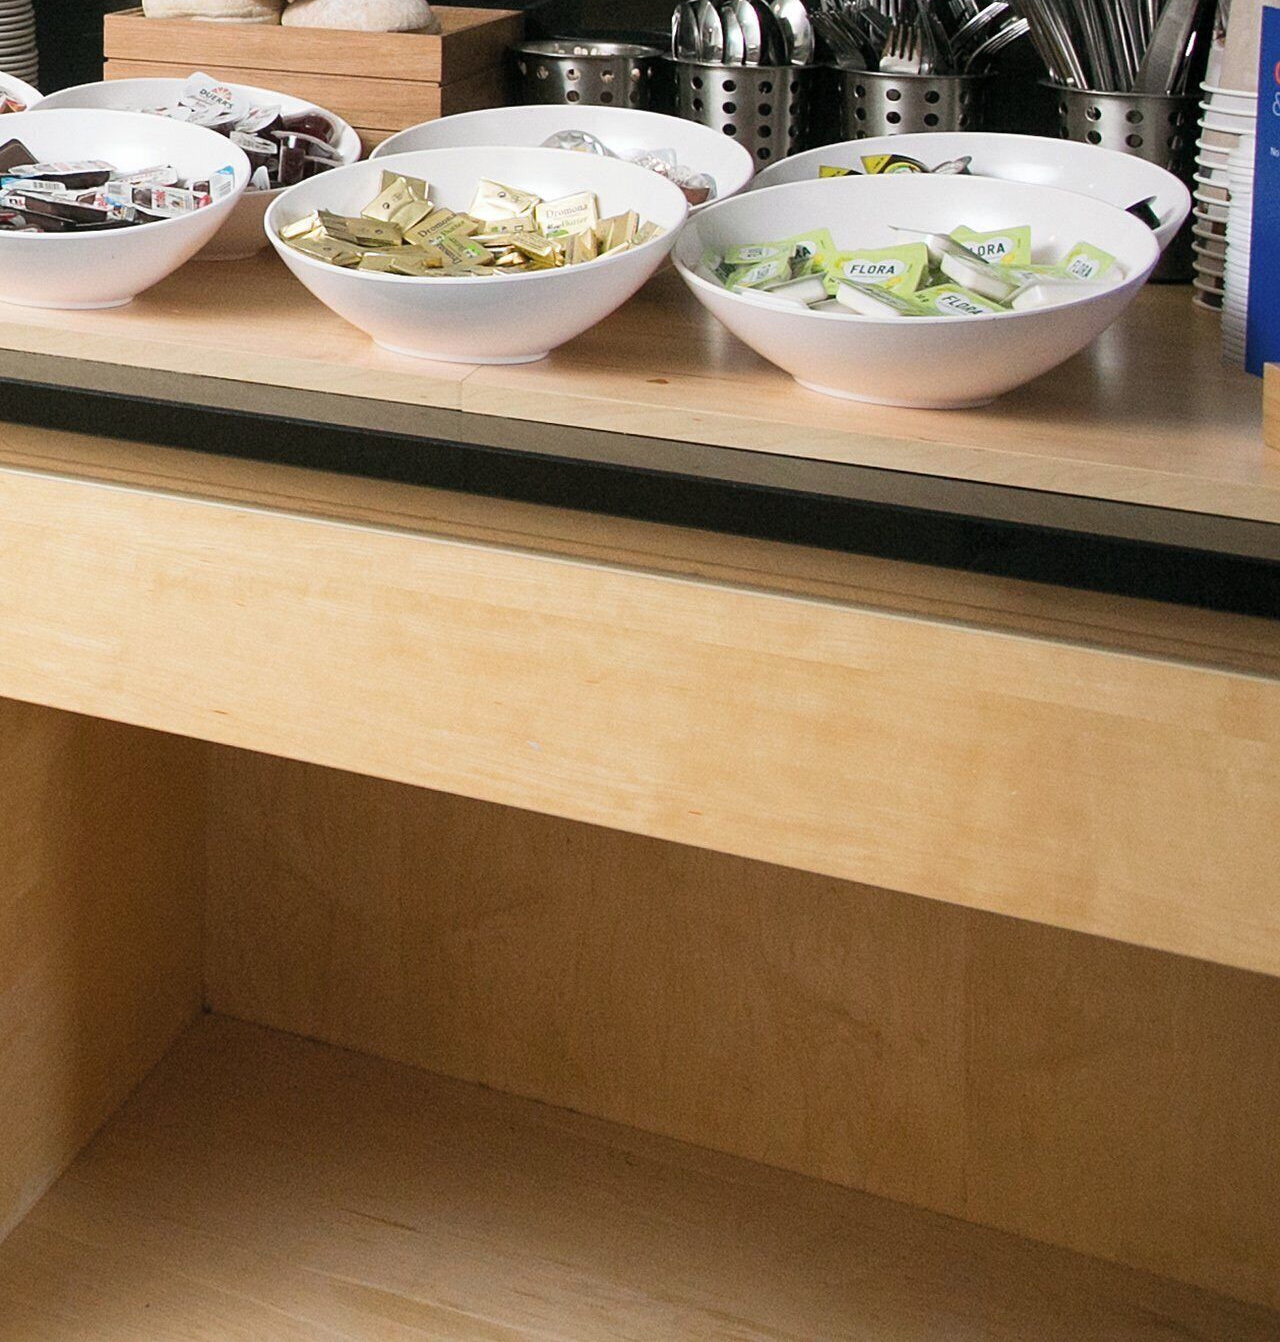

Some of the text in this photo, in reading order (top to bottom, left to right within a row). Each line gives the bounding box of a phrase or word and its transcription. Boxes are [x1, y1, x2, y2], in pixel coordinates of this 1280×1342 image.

[546, 204, 588, 218] Dromona
[849, 264, 896, 275] FLORA
[941, 295, 983, 314] FLORA
